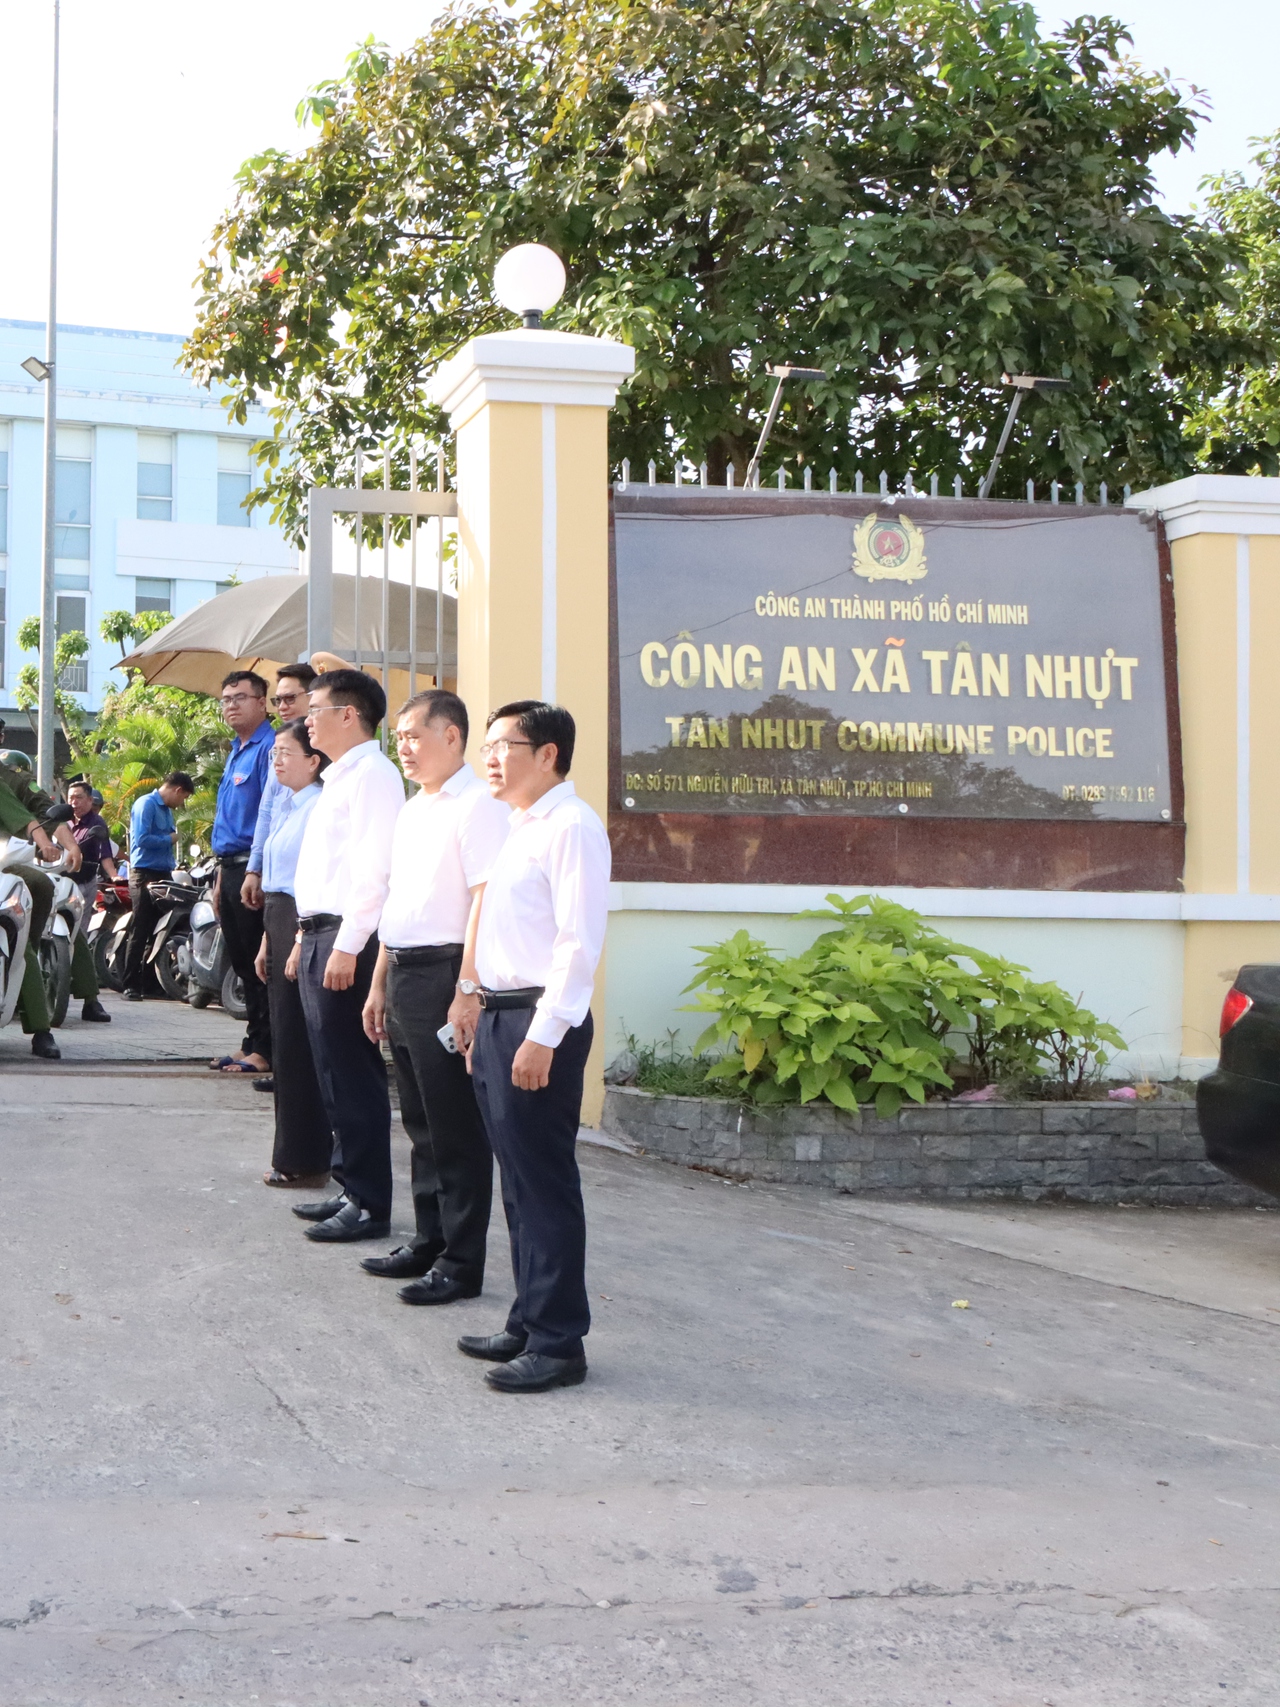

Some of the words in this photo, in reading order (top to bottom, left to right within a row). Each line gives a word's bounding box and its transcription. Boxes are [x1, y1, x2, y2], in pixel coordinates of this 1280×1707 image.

[755, 592, 800, 617] CÔNG
[804, 597, 826, 618] AN
[830, 594, 885, 620] THÀNH
[890, 594, 924, 621] PHỐ
[928, 594, 951, 622] HỒ
[956, 599, 983, 624] CHÍ
[987, 604, 1028, 625] MINH
[640, 629, 764, 691] CÔNG
[777, 646, 836, 691] AN
[851, 637, 911, 693] XÃ
[922, 640, 1009, 697] TÂN
[1025, 648, 1138, 709] NHỰT
[665, 717, 730, 748] TAN
[741, 718, 827, 750] NHUT
[837, 720, 994, 755] COMMUNE
[1007, 725, 1114, 758] POLICE
[664, 775, 684, 792] 571
[906, 781, 933, 797] MINH
[1137, 786, 1155, 802] 116
